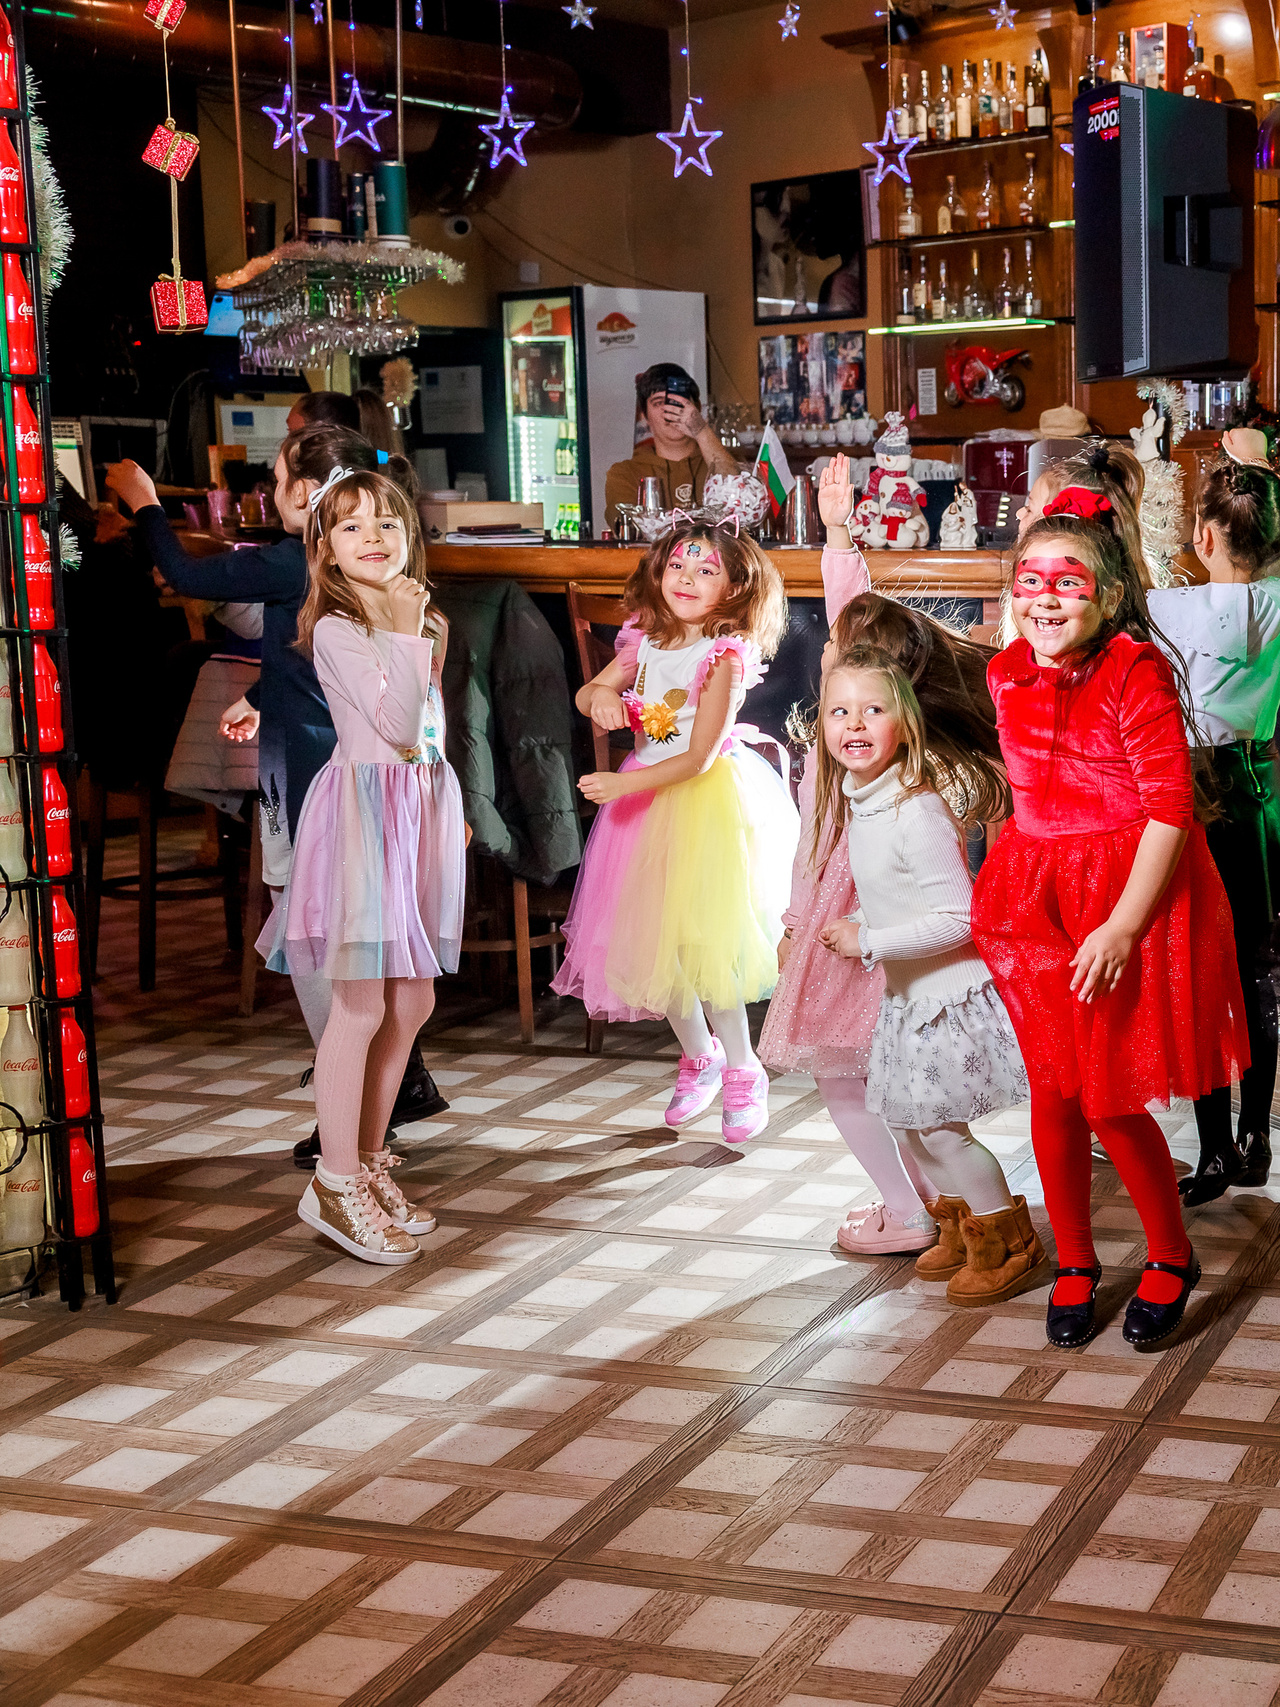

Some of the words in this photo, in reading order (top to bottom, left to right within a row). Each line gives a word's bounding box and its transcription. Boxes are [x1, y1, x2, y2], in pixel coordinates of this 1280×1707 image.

[1087, 108, 1118, 134] 2000
[4, 1058, 38, 1072] Coca-Cola
[6, 1178, 41, 1192] Coca-Cola
